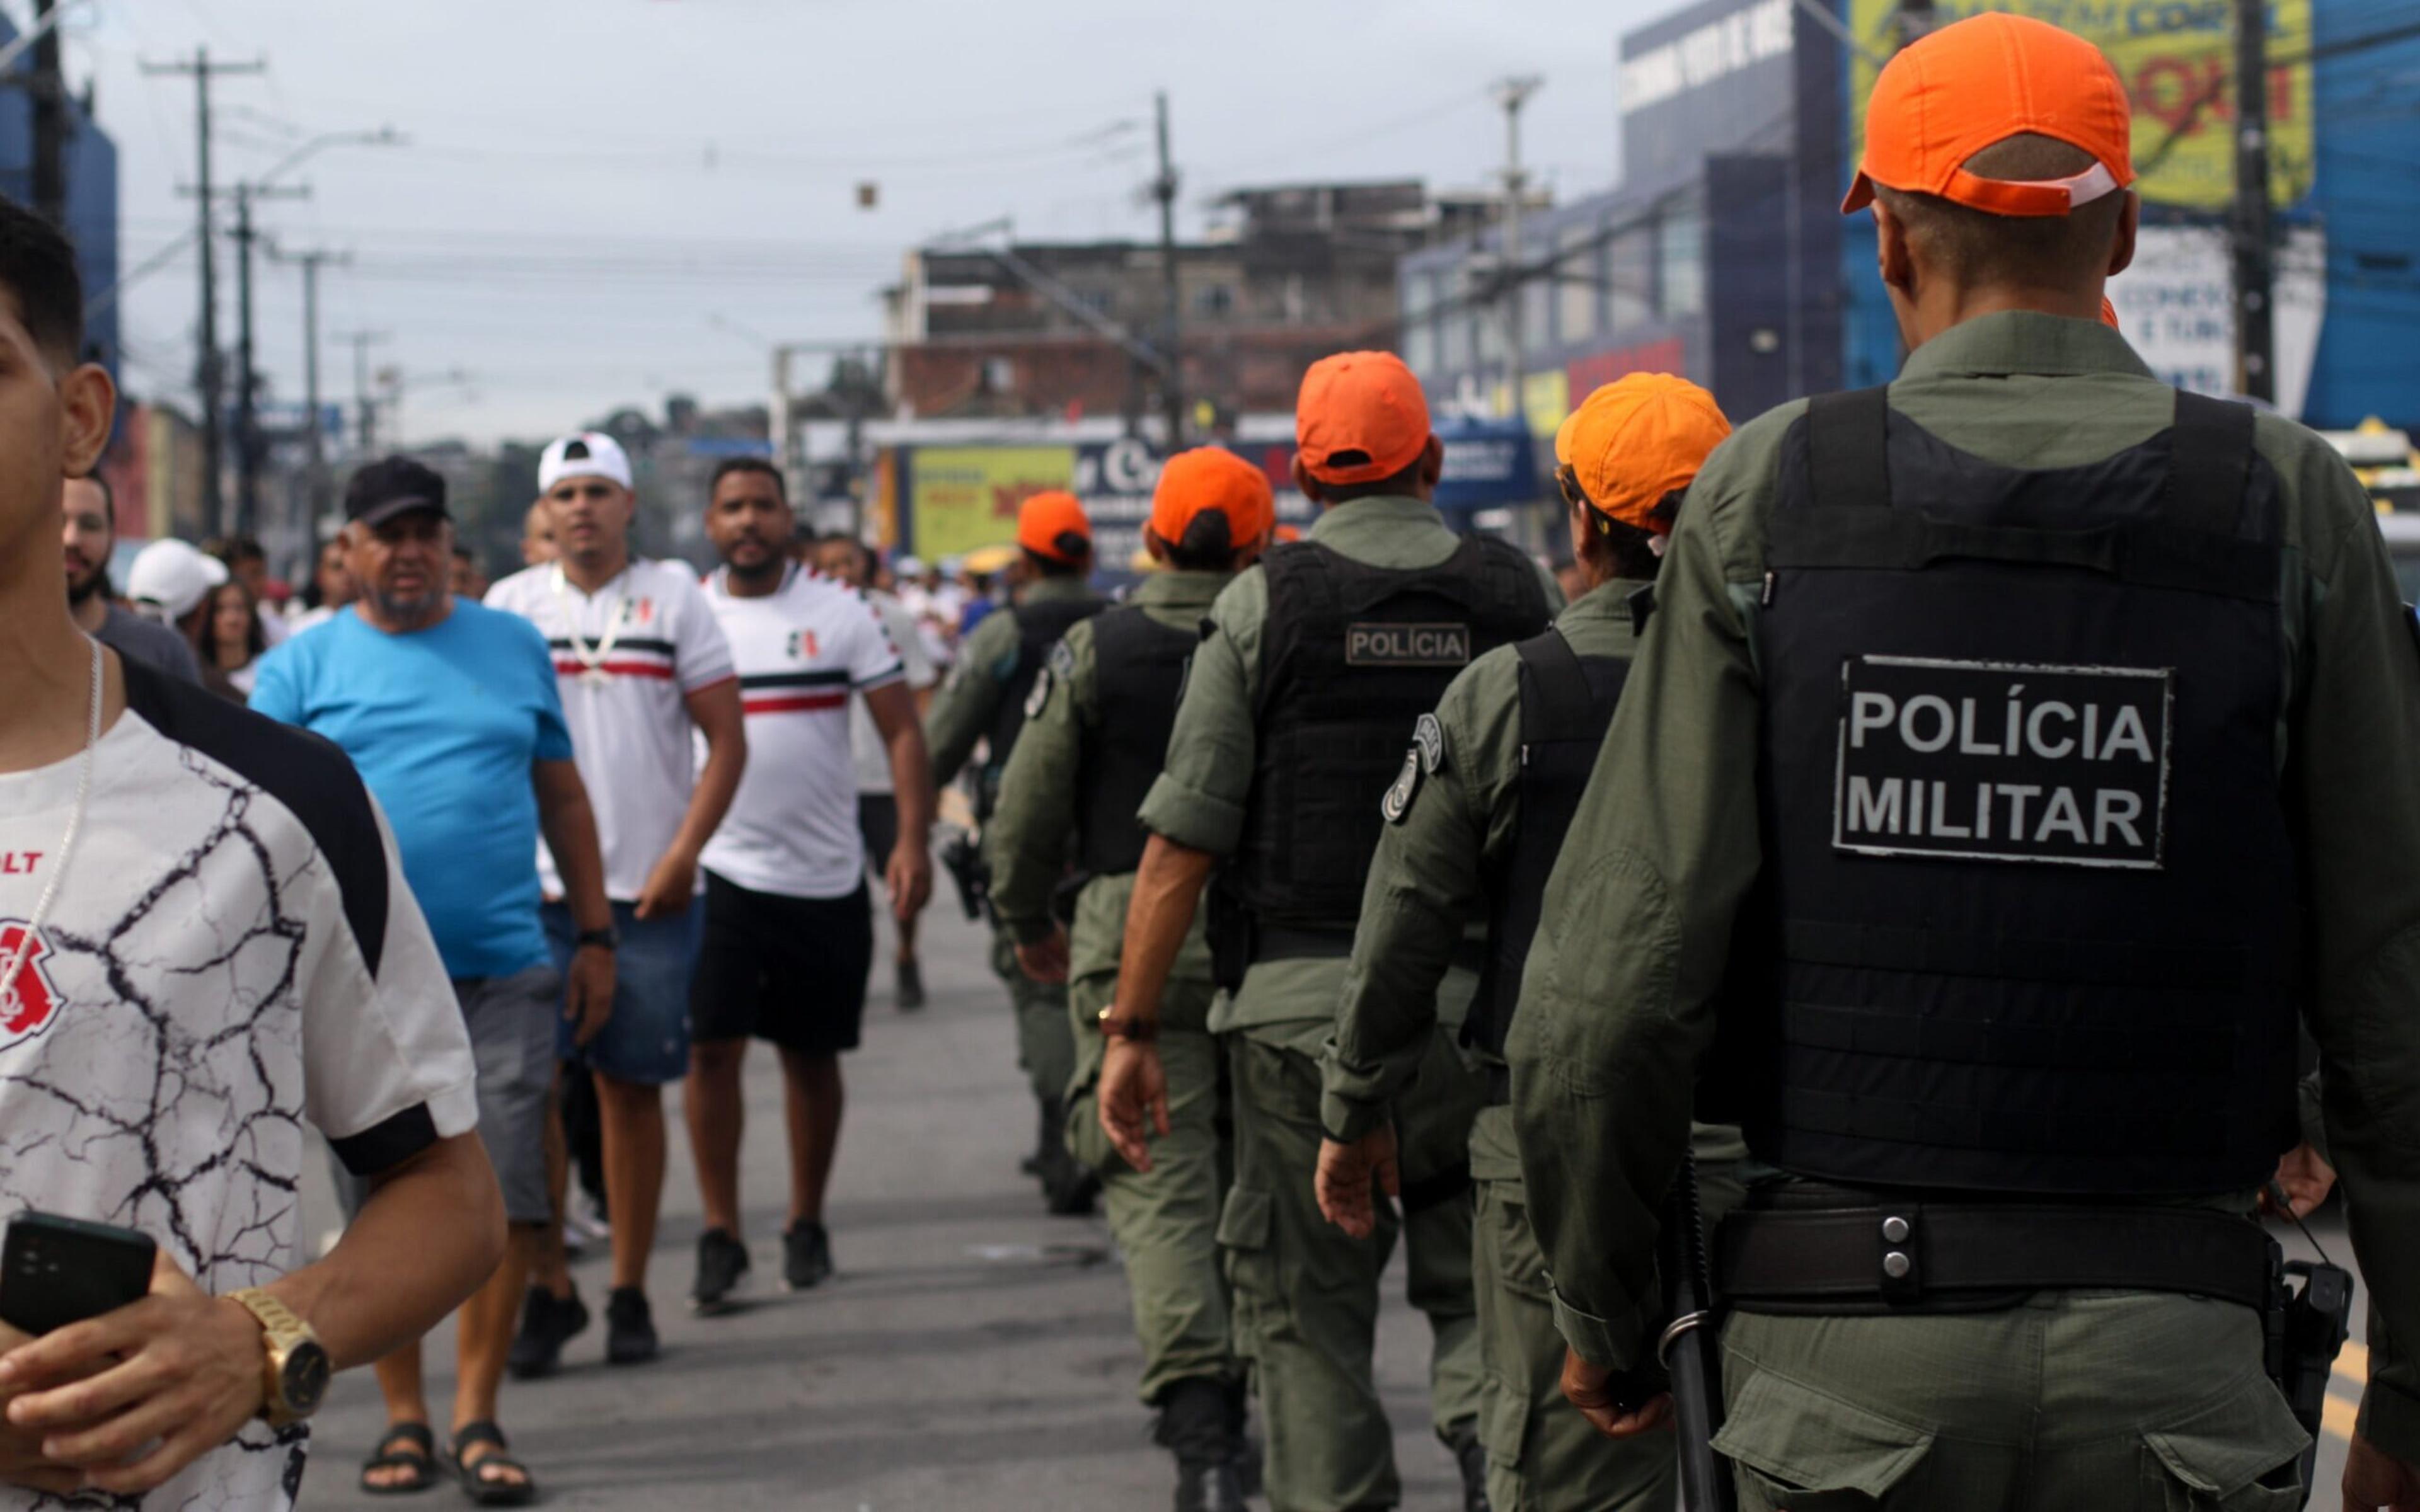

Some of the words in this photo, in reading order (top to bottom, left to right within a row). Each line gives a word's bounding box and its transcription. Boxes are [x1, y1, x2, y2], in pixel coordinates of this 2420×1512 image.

[1351, 627, 1463, 656] POLÍCIA
[1850, 684, 2155, 763] POLÍCIA
[1847, 776, 2143, 847] MILITAR
[0, 852, 43, 874] LT
